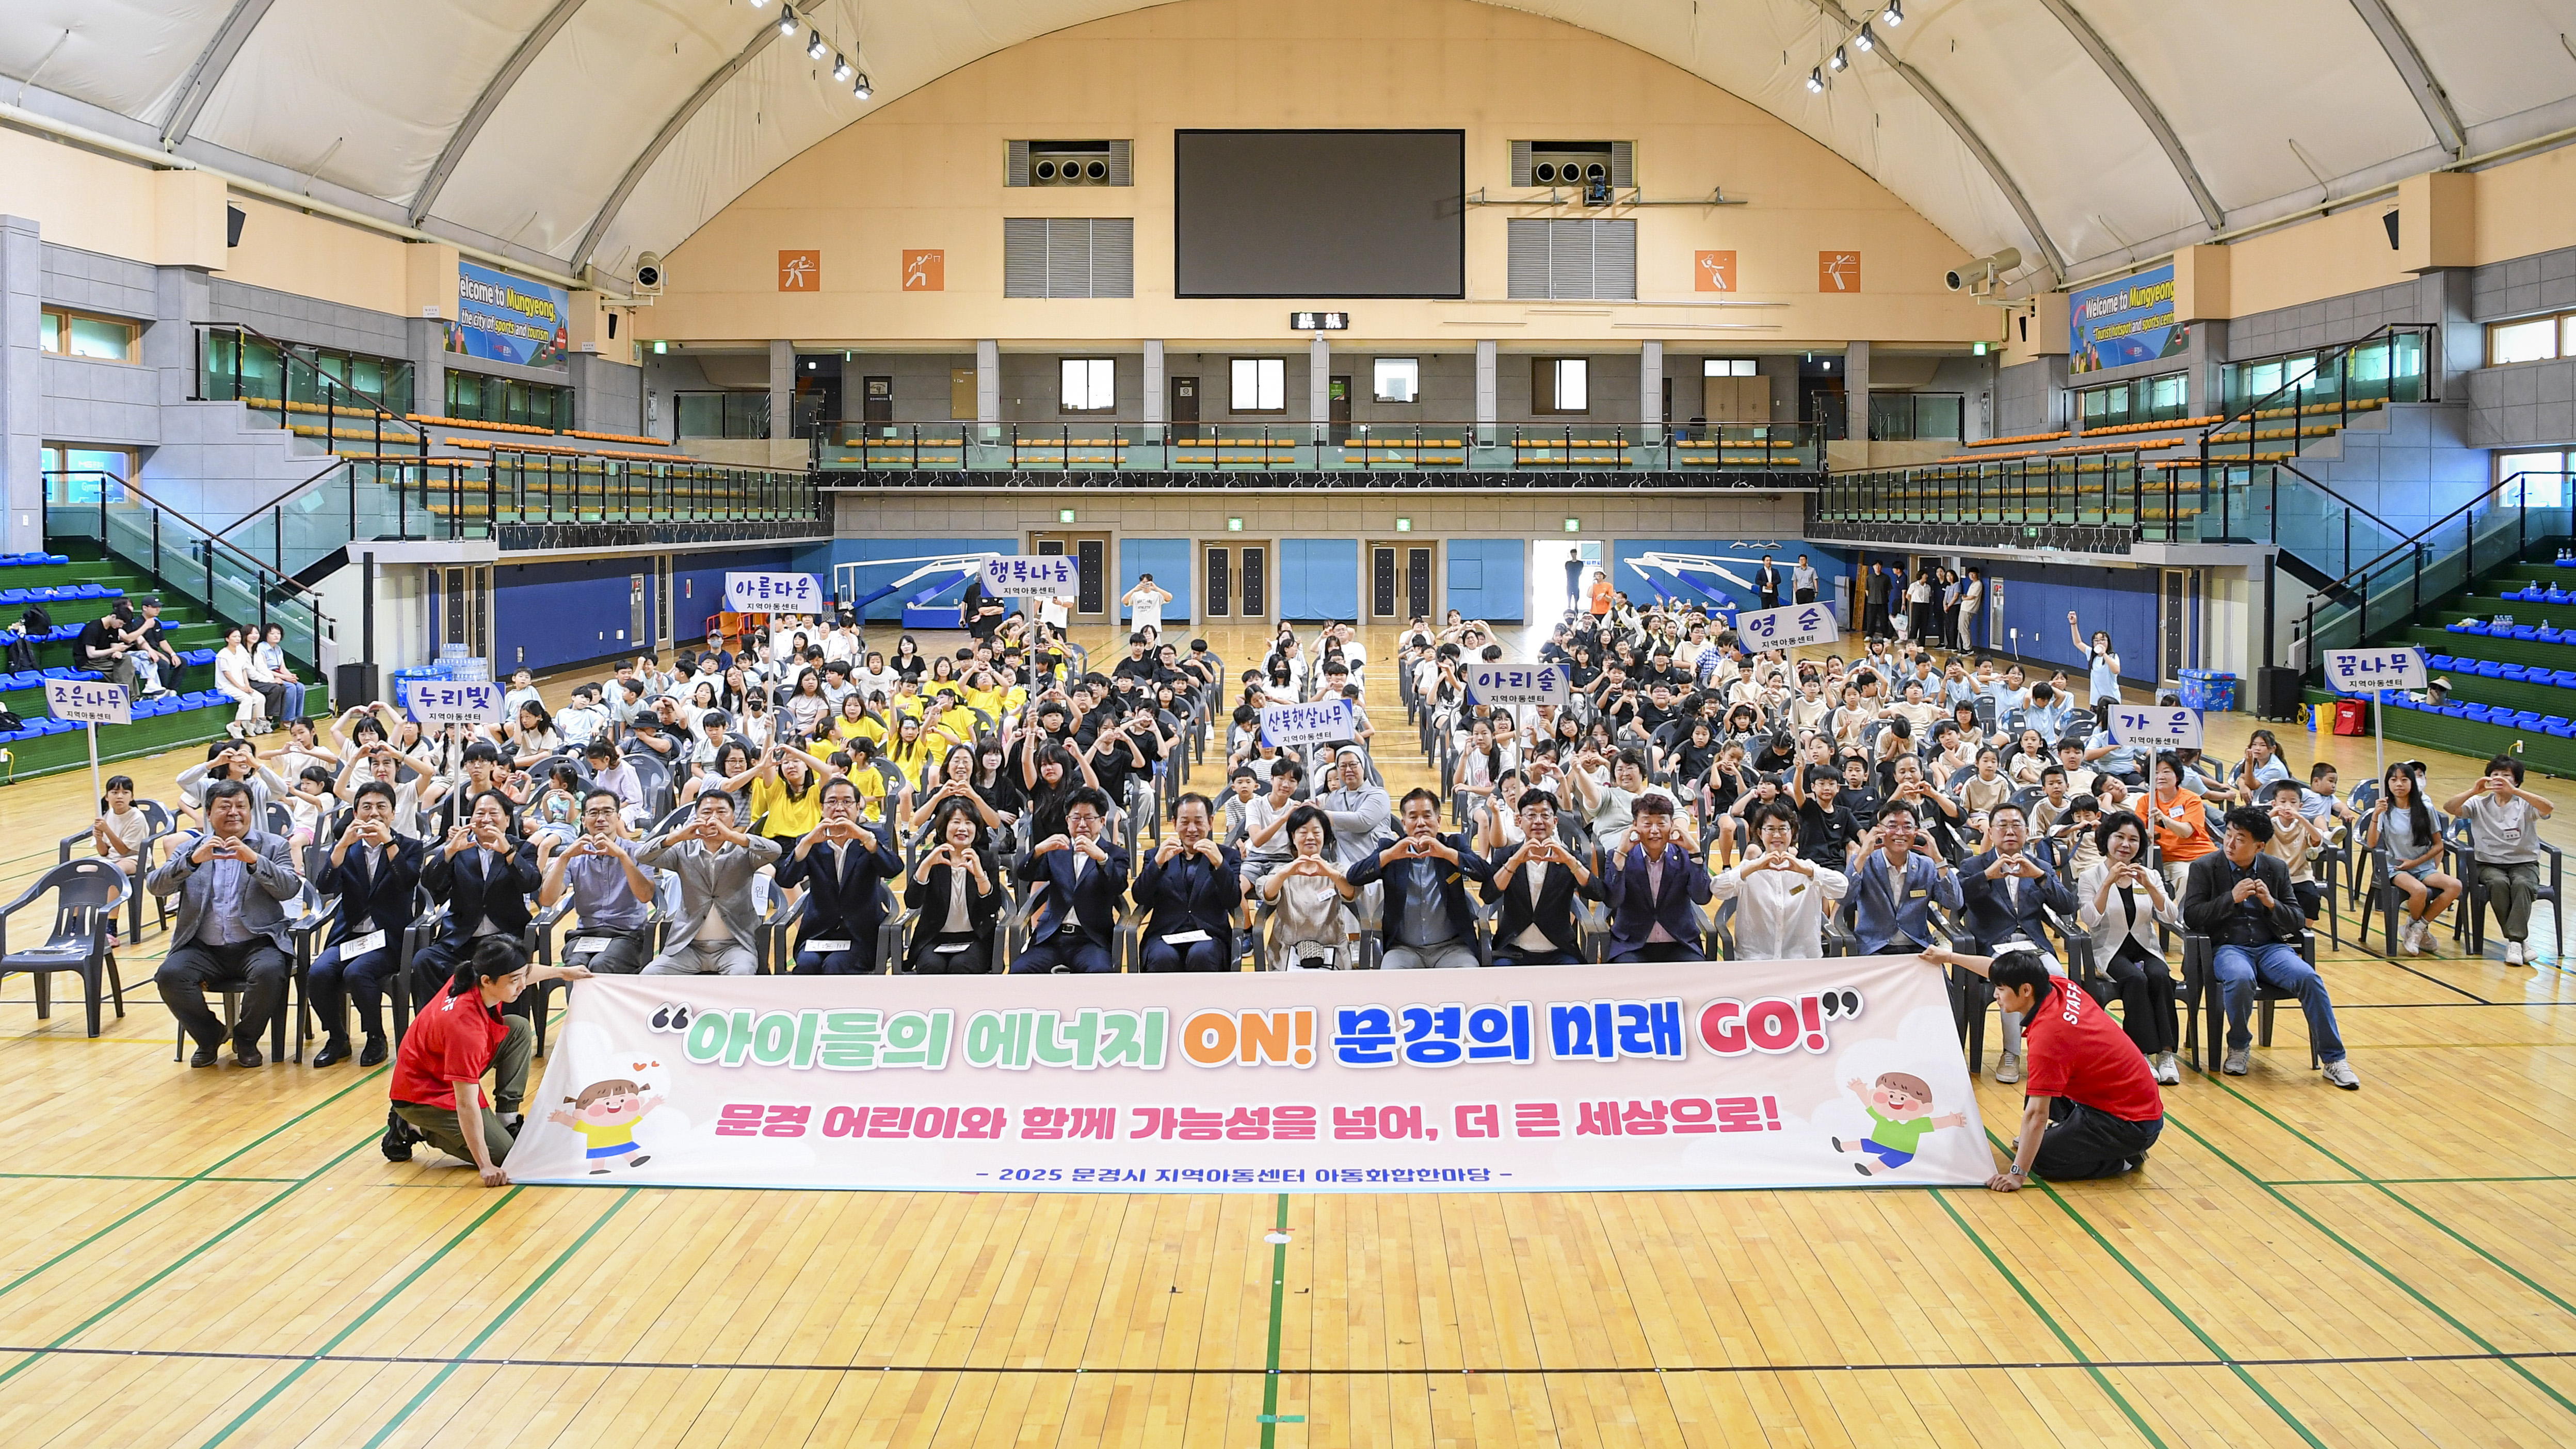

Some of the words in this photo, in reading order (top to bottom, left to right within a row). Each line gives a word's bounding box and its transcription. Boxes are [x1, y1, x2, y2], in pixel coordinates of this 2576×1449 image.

[459, 273, 494, 305] elcome
[495, 284, 505, 307] to
[506, 287, 557, 323] Mungyeong,
[2086, 295, 2118, 319] Welcome
[2119, 290, 2128, 311] to
[461, 309, 473, 326] the
[473, 312, 486, 331] city
[487, 315, 495, 330] of
[495, 319, 515, 335] sports
[516, 324, 526, 336] and
[527, 325, 550, 342] tourism
[2112, 321, 2132, 337] hotspot
[2132, 318, 2142, 332] and
[2142, 315, 2159, 331] sports
[989, 559, 1069, 583] 행복나눔
[736, 576, 810, 599] 아름다운
[1003, 586, 1056, 594] 지역아동센터
[1761, 634, 1814, 648] 지역아동센터
[2337, 653, 2409, 677] 꿈나무
[1478, 667, 1556, 691] 아리솔
[2349, 679, 2403, 688] 지역아동센터
[55, 685, 121, 709] 조은나무
[418, 686, 490, 709] 누리빛
[1490, 695, 1544, 703] 지역아동센터
[67, 711, 111, 720] 지역아동센터
[429, 713, 481, 721] 지역아동센터
[1268, 705, 1342, 732] 산북햇살나무
[1282, 731, 1332, 743] 지역아동센터
[2129, 736, 2180, 745] 지역아동센터
[2062, 982, 2082, 1025] STAFF
[968, 1011, 1164, 1066] 에너지
[1184, 1011, 1312, 1065] ON!
[1334, 1006, 1531, 1064] 문경의
[1551, 1002, 1682, 1058] 미래
[715, 1104, 811, 1137] 문경
[822, 1106, 1007, 1139] 어린이와
[1021, 1107, 1116, 1139] 함께
[1130, 1106, 1316, 1140] 가능성을
[1333, 1105, 1438, 1141] 넘어,
[1455, 1104, 1500, 1138] 더
[1515, 1103, 1560, 1137] 큰
[1576, 1096, 1782, 1136] 세상으로!
[999, 1169, 1062, 1181] 2025
[1072, 1168, 1146, 1183] 문경시
[1157, 1168, 1305, 1183] 지역아동센터
[1315, 1168, 1491, 1183] 아동화합한마당
